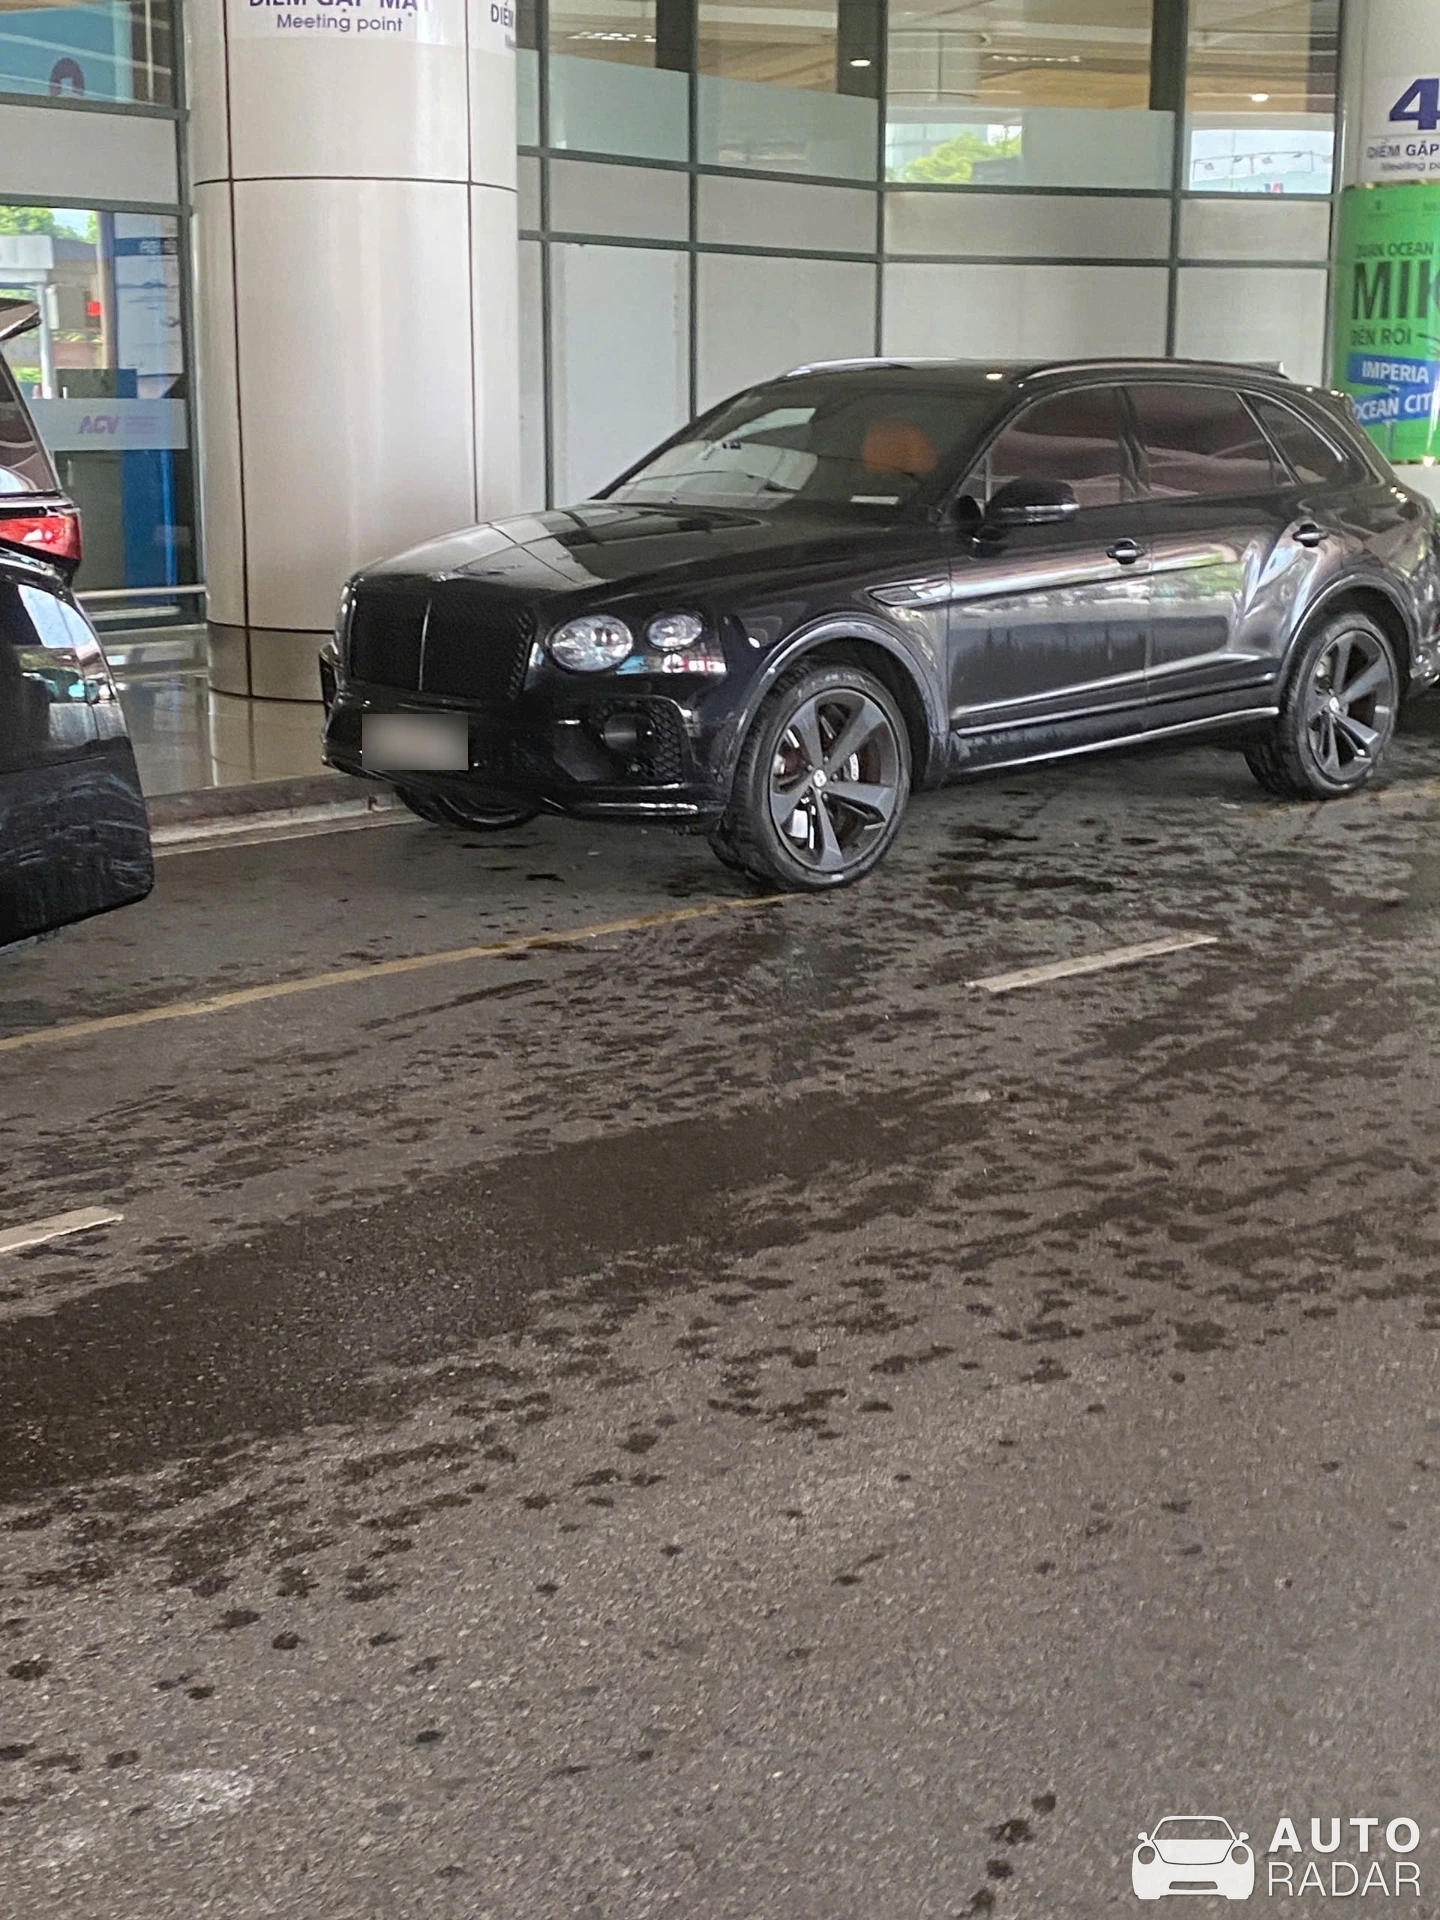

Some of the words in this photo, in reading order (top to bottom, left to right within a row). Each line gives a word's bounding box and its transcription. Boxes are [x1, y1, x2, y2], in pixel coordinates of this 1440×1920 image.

[277, 13, 350, 33] Meeting
[357, 16, 402, 33] point
[1389, 78, 1440, 130] 4
[1388, 241, 1434, 256] OCEAN
[1362, 361, 1429, 384] IMPERIA
[1404, 392, 1434, 414] CIT
